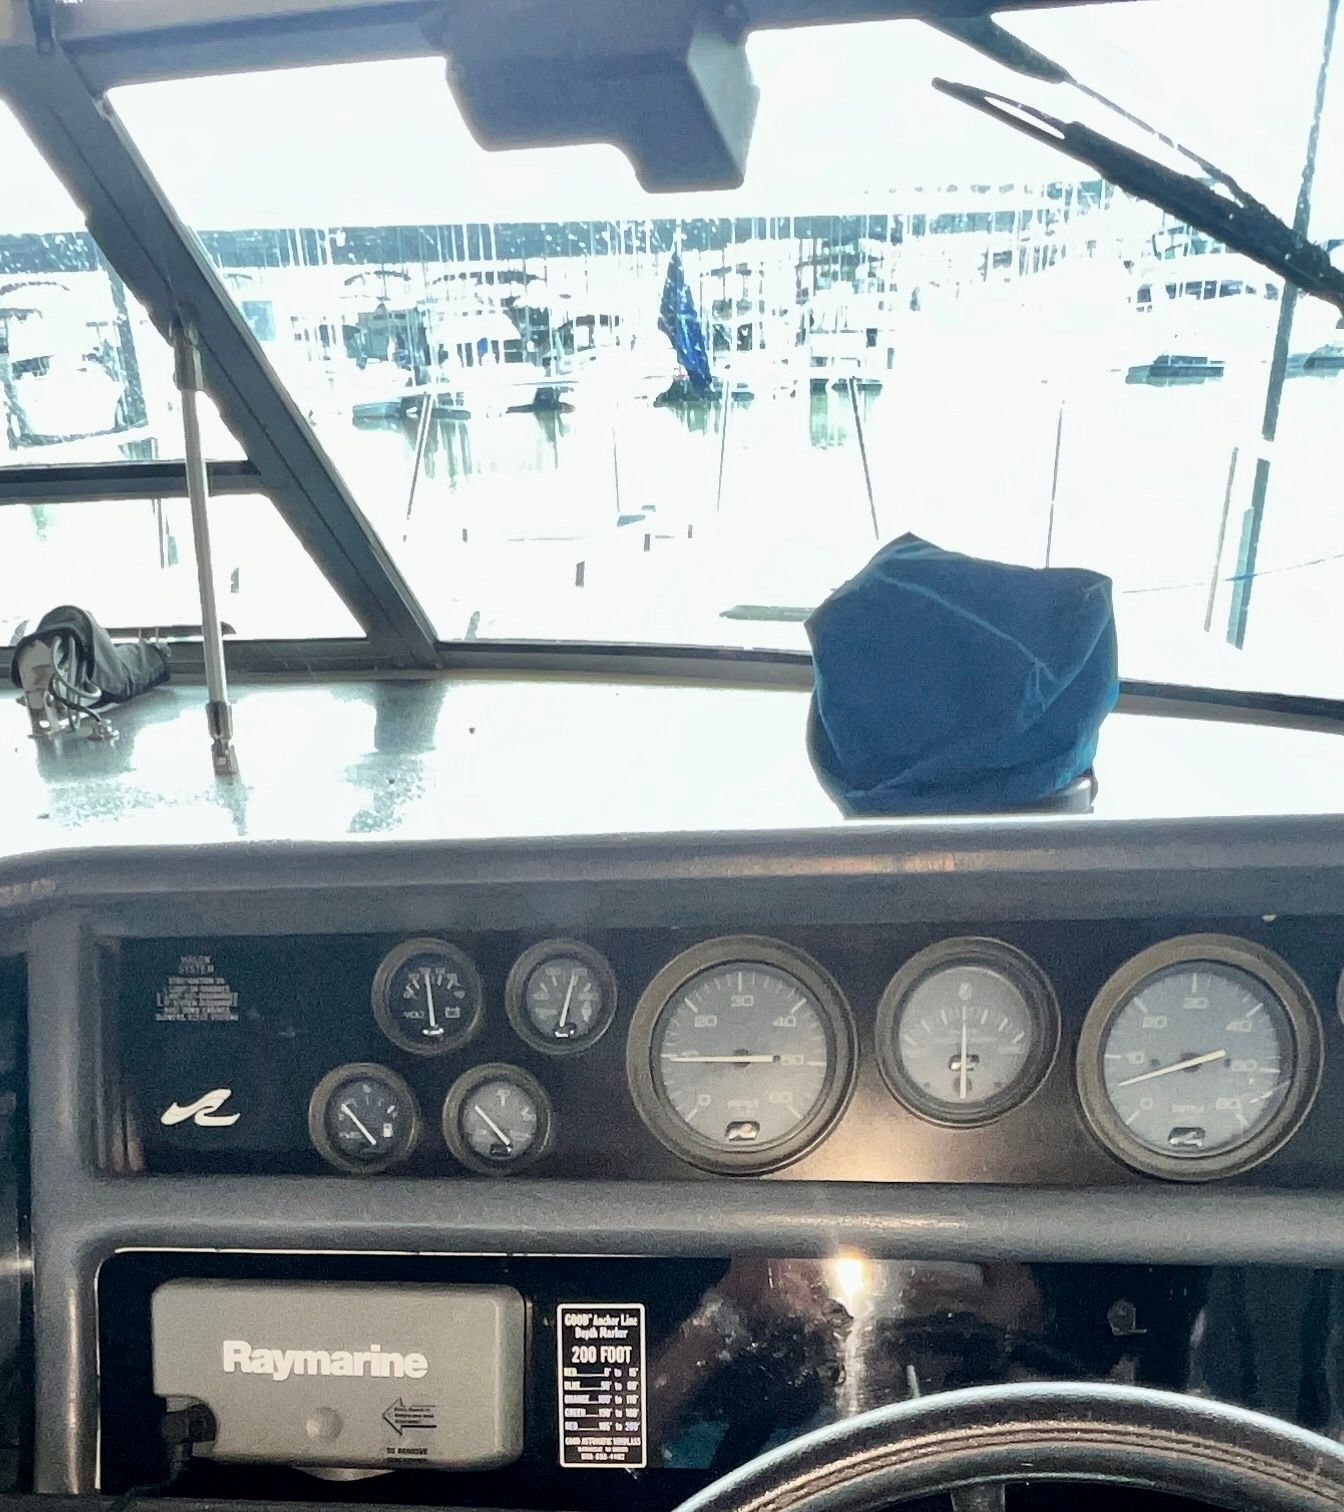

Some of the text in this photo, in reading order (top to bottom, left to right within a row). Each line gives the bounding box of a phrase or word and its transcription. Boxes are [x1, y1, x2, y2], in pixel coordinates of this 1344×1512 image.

[731, 995, 754, 1007] 30
[774, 1016, 797, 1027] 40
[593, 1314, 619, 1326] Anchor
[620, 1314, 638, 1326] Line
[575, 1327, 628, 1340] Depth Marker
[223, 1340, 429, 1381] Raymarine
[571, 1345, 632, 1364] 200 FOOT
